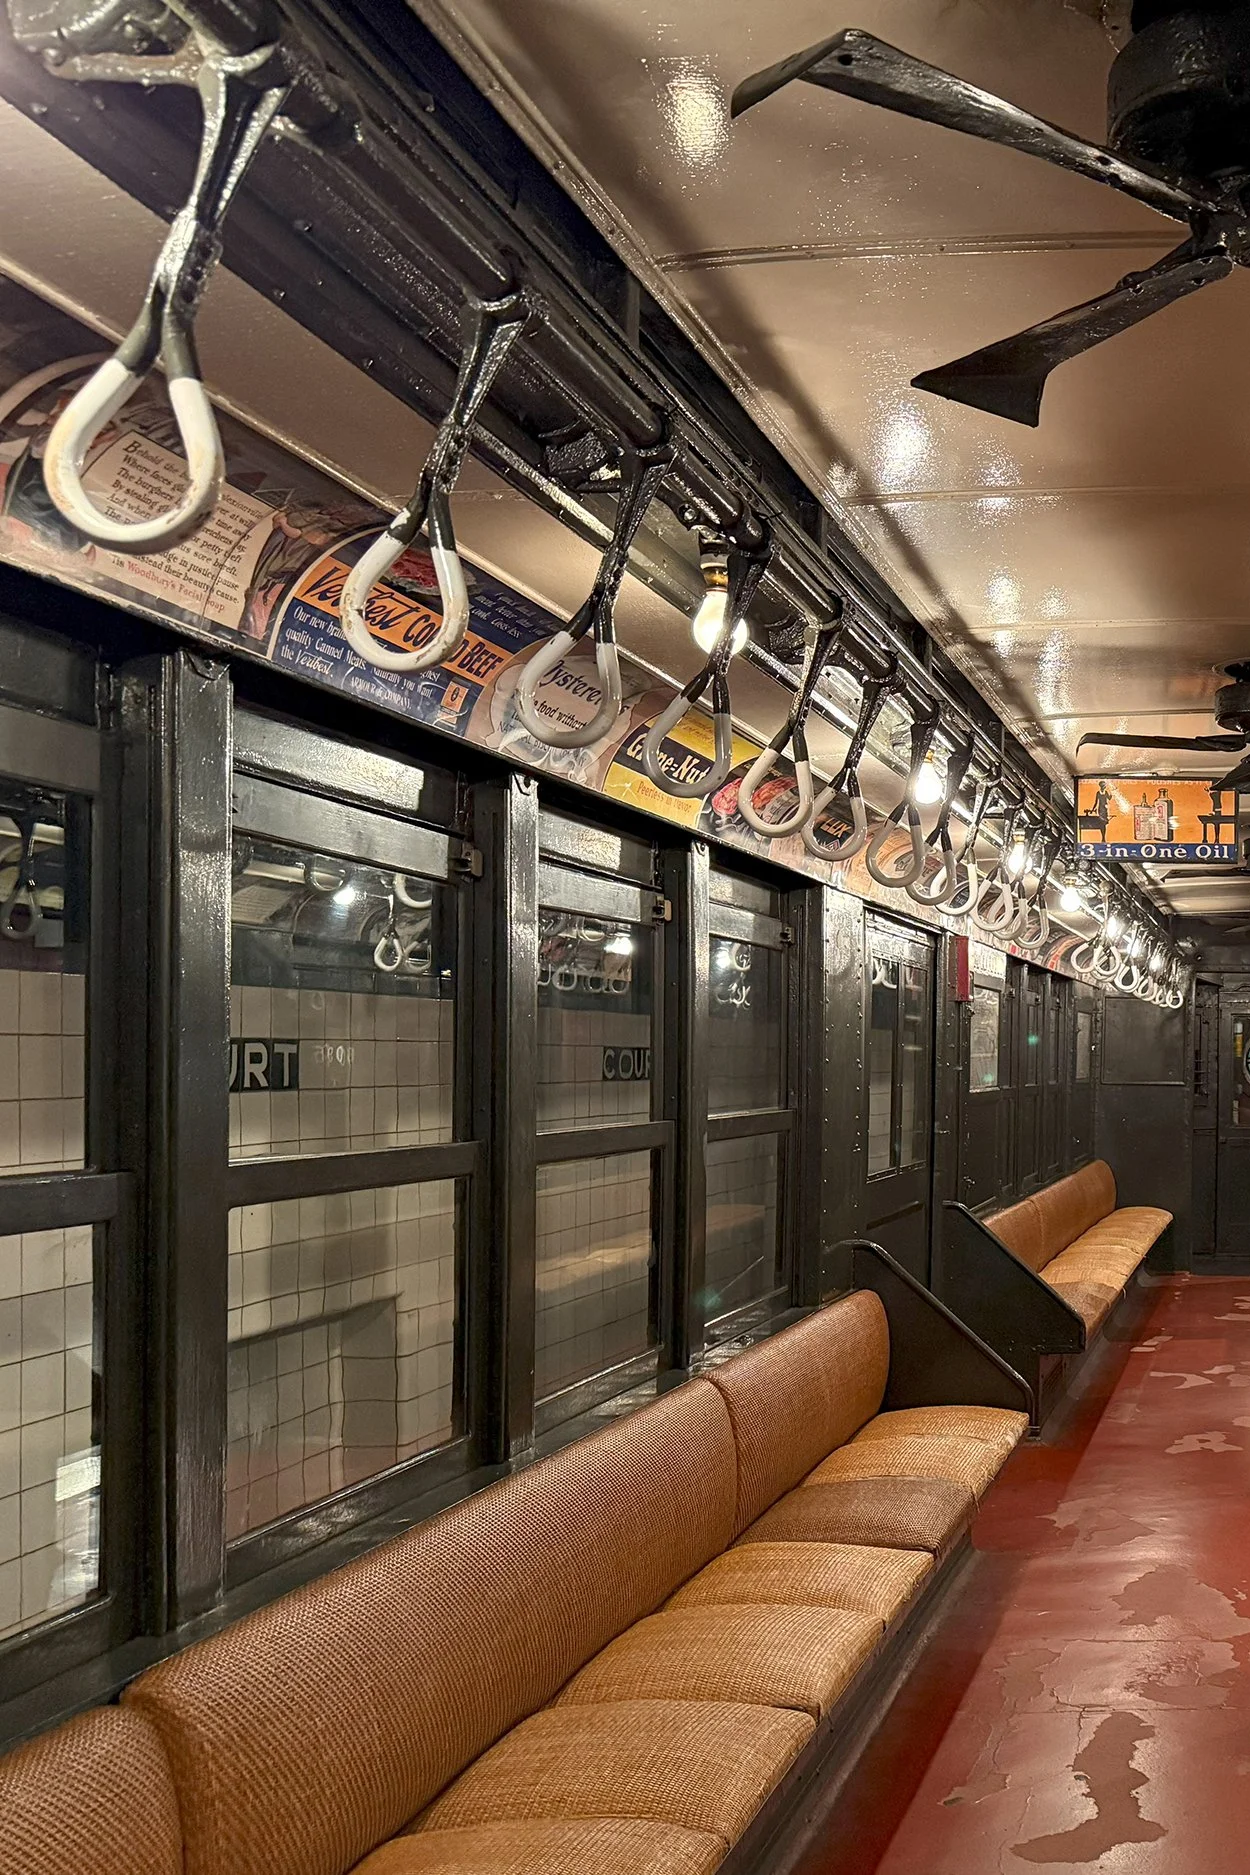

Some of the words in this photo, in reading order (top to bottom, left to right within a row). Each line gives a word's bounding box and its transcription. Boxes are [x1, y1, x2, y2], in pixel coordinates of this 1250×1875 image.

[124, 440, 161, 466] Behold
[123, 454, 149, 476] Where
[150, 470, 172, 486] faces
[111, 479, 125, 493] By
[124, 488, 158, 512] stealing
[117, 467, 133, 481] The
[134, 476, 174, 503] burghers
[106, 493, 125, 508] And
[200, 540, 224, 556] petty
[192, 550, 213, 565] sore
[126, 560, 177, 590] Woodbury's
[178, 583, 204, 602] Facial
[163, 563, 184, 579] their
[293, 605, 311, 624] Our
[309, 617, 328, 631] new
[280, 644, 294, 661] the
[285, 627, 315, 650] quality
[314, 637, 345, 660] Canned
[401, 679, 416, 691] you
[457, 642, 505, 680] BEEF
[536, 700, 558, 718] food
[636, 780, 665, 802] Peerless
[820, 817, 854, 839] LUX
[1080, 844, 1188, 859] 3-in-One
[1195, 844, 1230, 860] Oil
